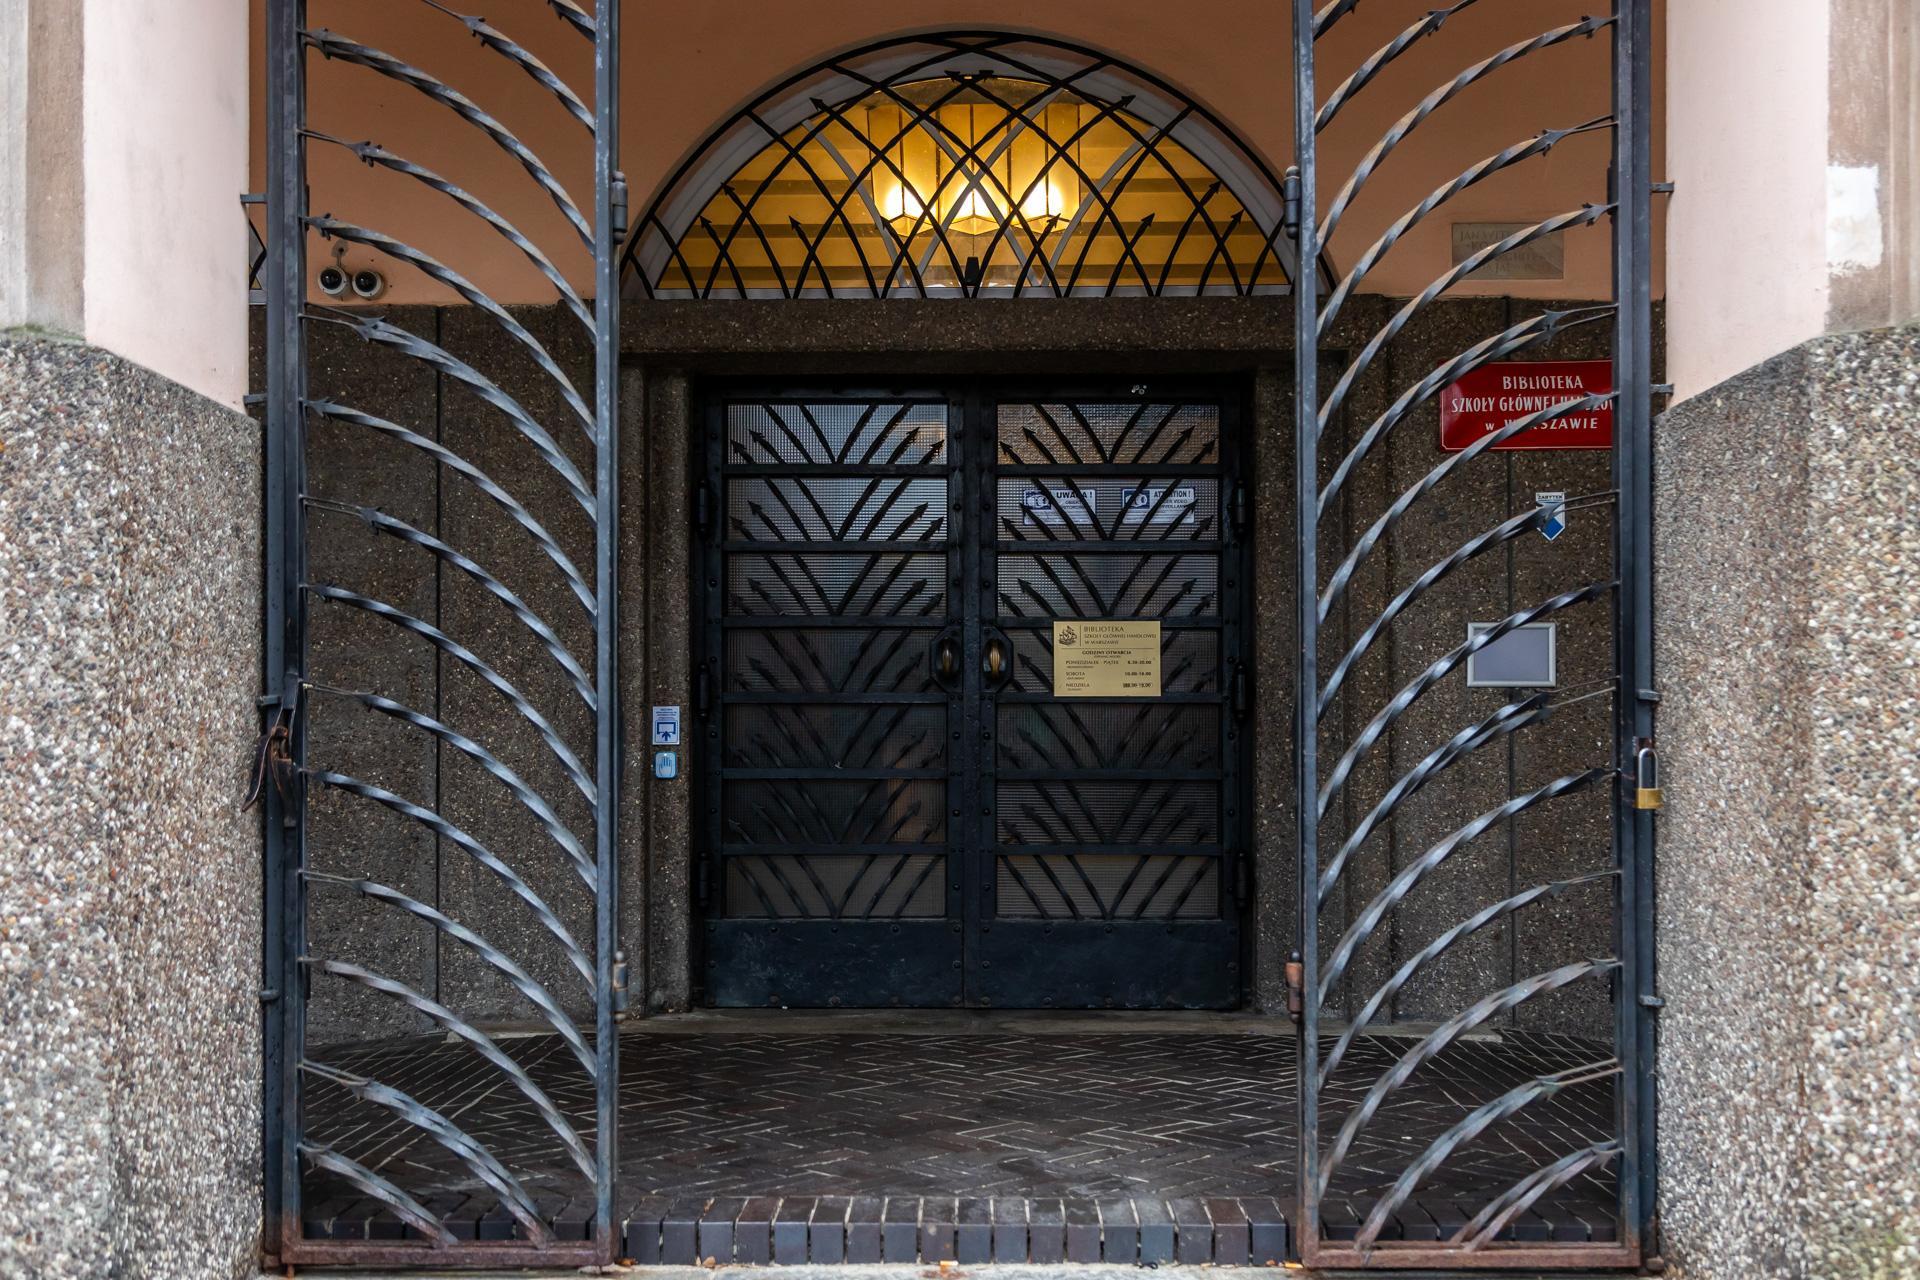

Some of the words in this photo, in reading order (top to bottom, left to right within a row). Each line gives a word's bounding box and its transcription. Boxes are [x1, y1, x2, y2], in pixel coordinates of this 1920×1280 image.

[1502, 375, 1584, 390] BIBLIOTEKA
[1451, 397, 1495, 413] SZKOŁY
[1056, 491, 1088, 499] UWAA
